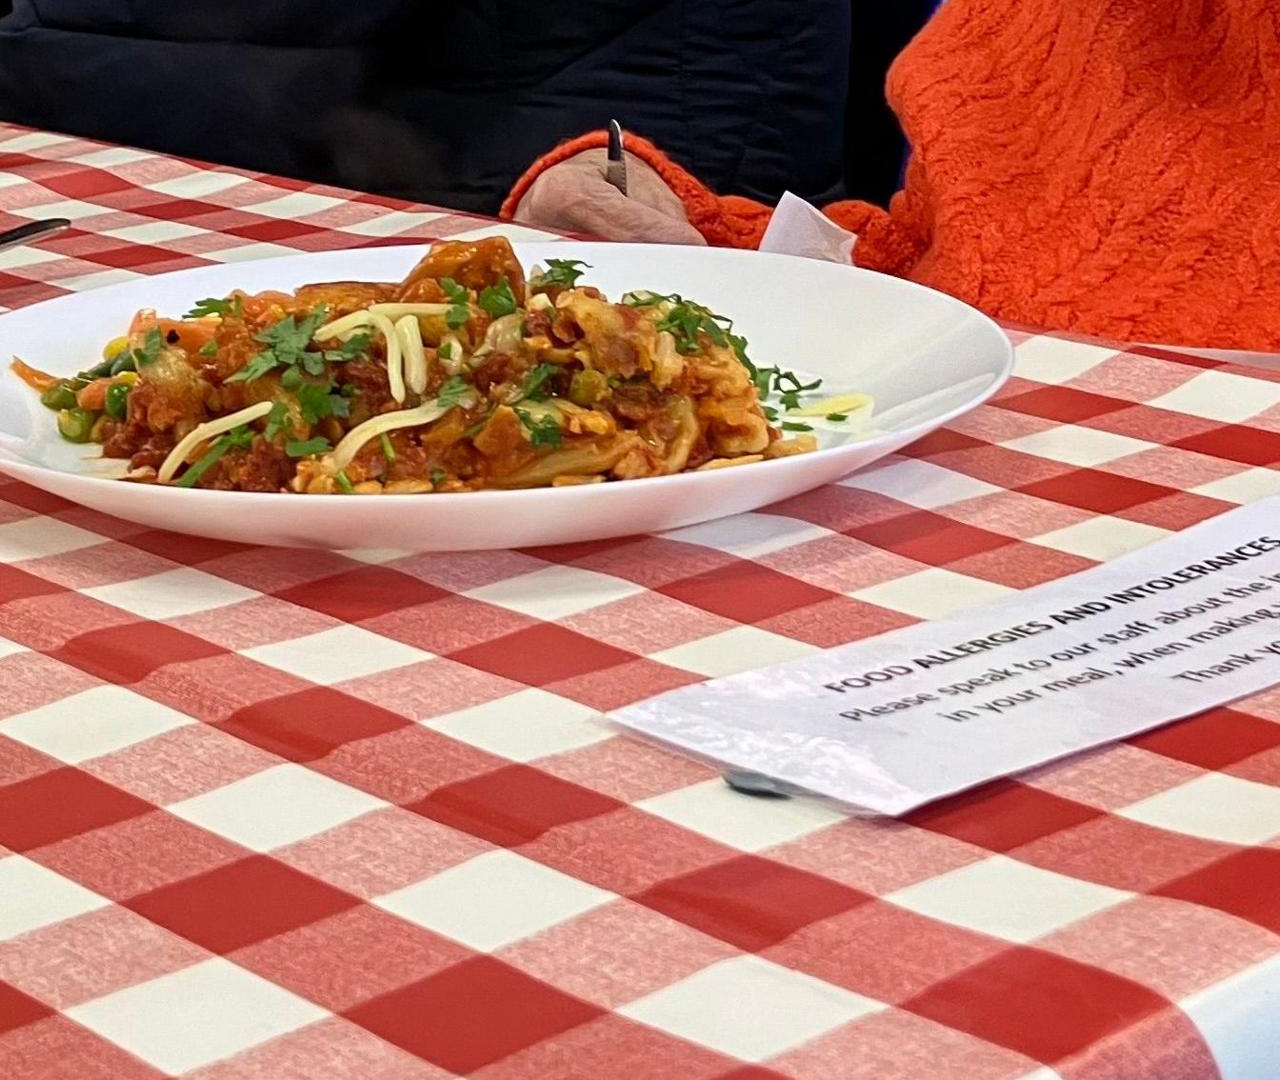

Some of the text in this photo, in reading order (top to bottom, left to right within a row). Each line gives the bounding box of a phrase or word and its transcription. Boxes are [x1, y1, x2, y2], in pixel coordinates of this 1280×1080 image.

[824, 664, 914, 694] FOOD
[913, 620, 1054, 670] ALLERGIES
[1049, 600, 1112, 626] AND
[839, 690, 941, 722] Please
[937, 666, 1021, 699] speak
[1014, 657, 1053, 673] to
[1050, 641, 1100, 662] our
[1097, 619, 1157, 646] staff
[1153, 595, 1231, 625] about
[1221, 578, 1272, 602] the
[937, 710, 980, 722] in
[973, 687, 1044, 714] your
[1113, 639, 1194, 670] when
[1172, 651, 1267, 684] Thank
